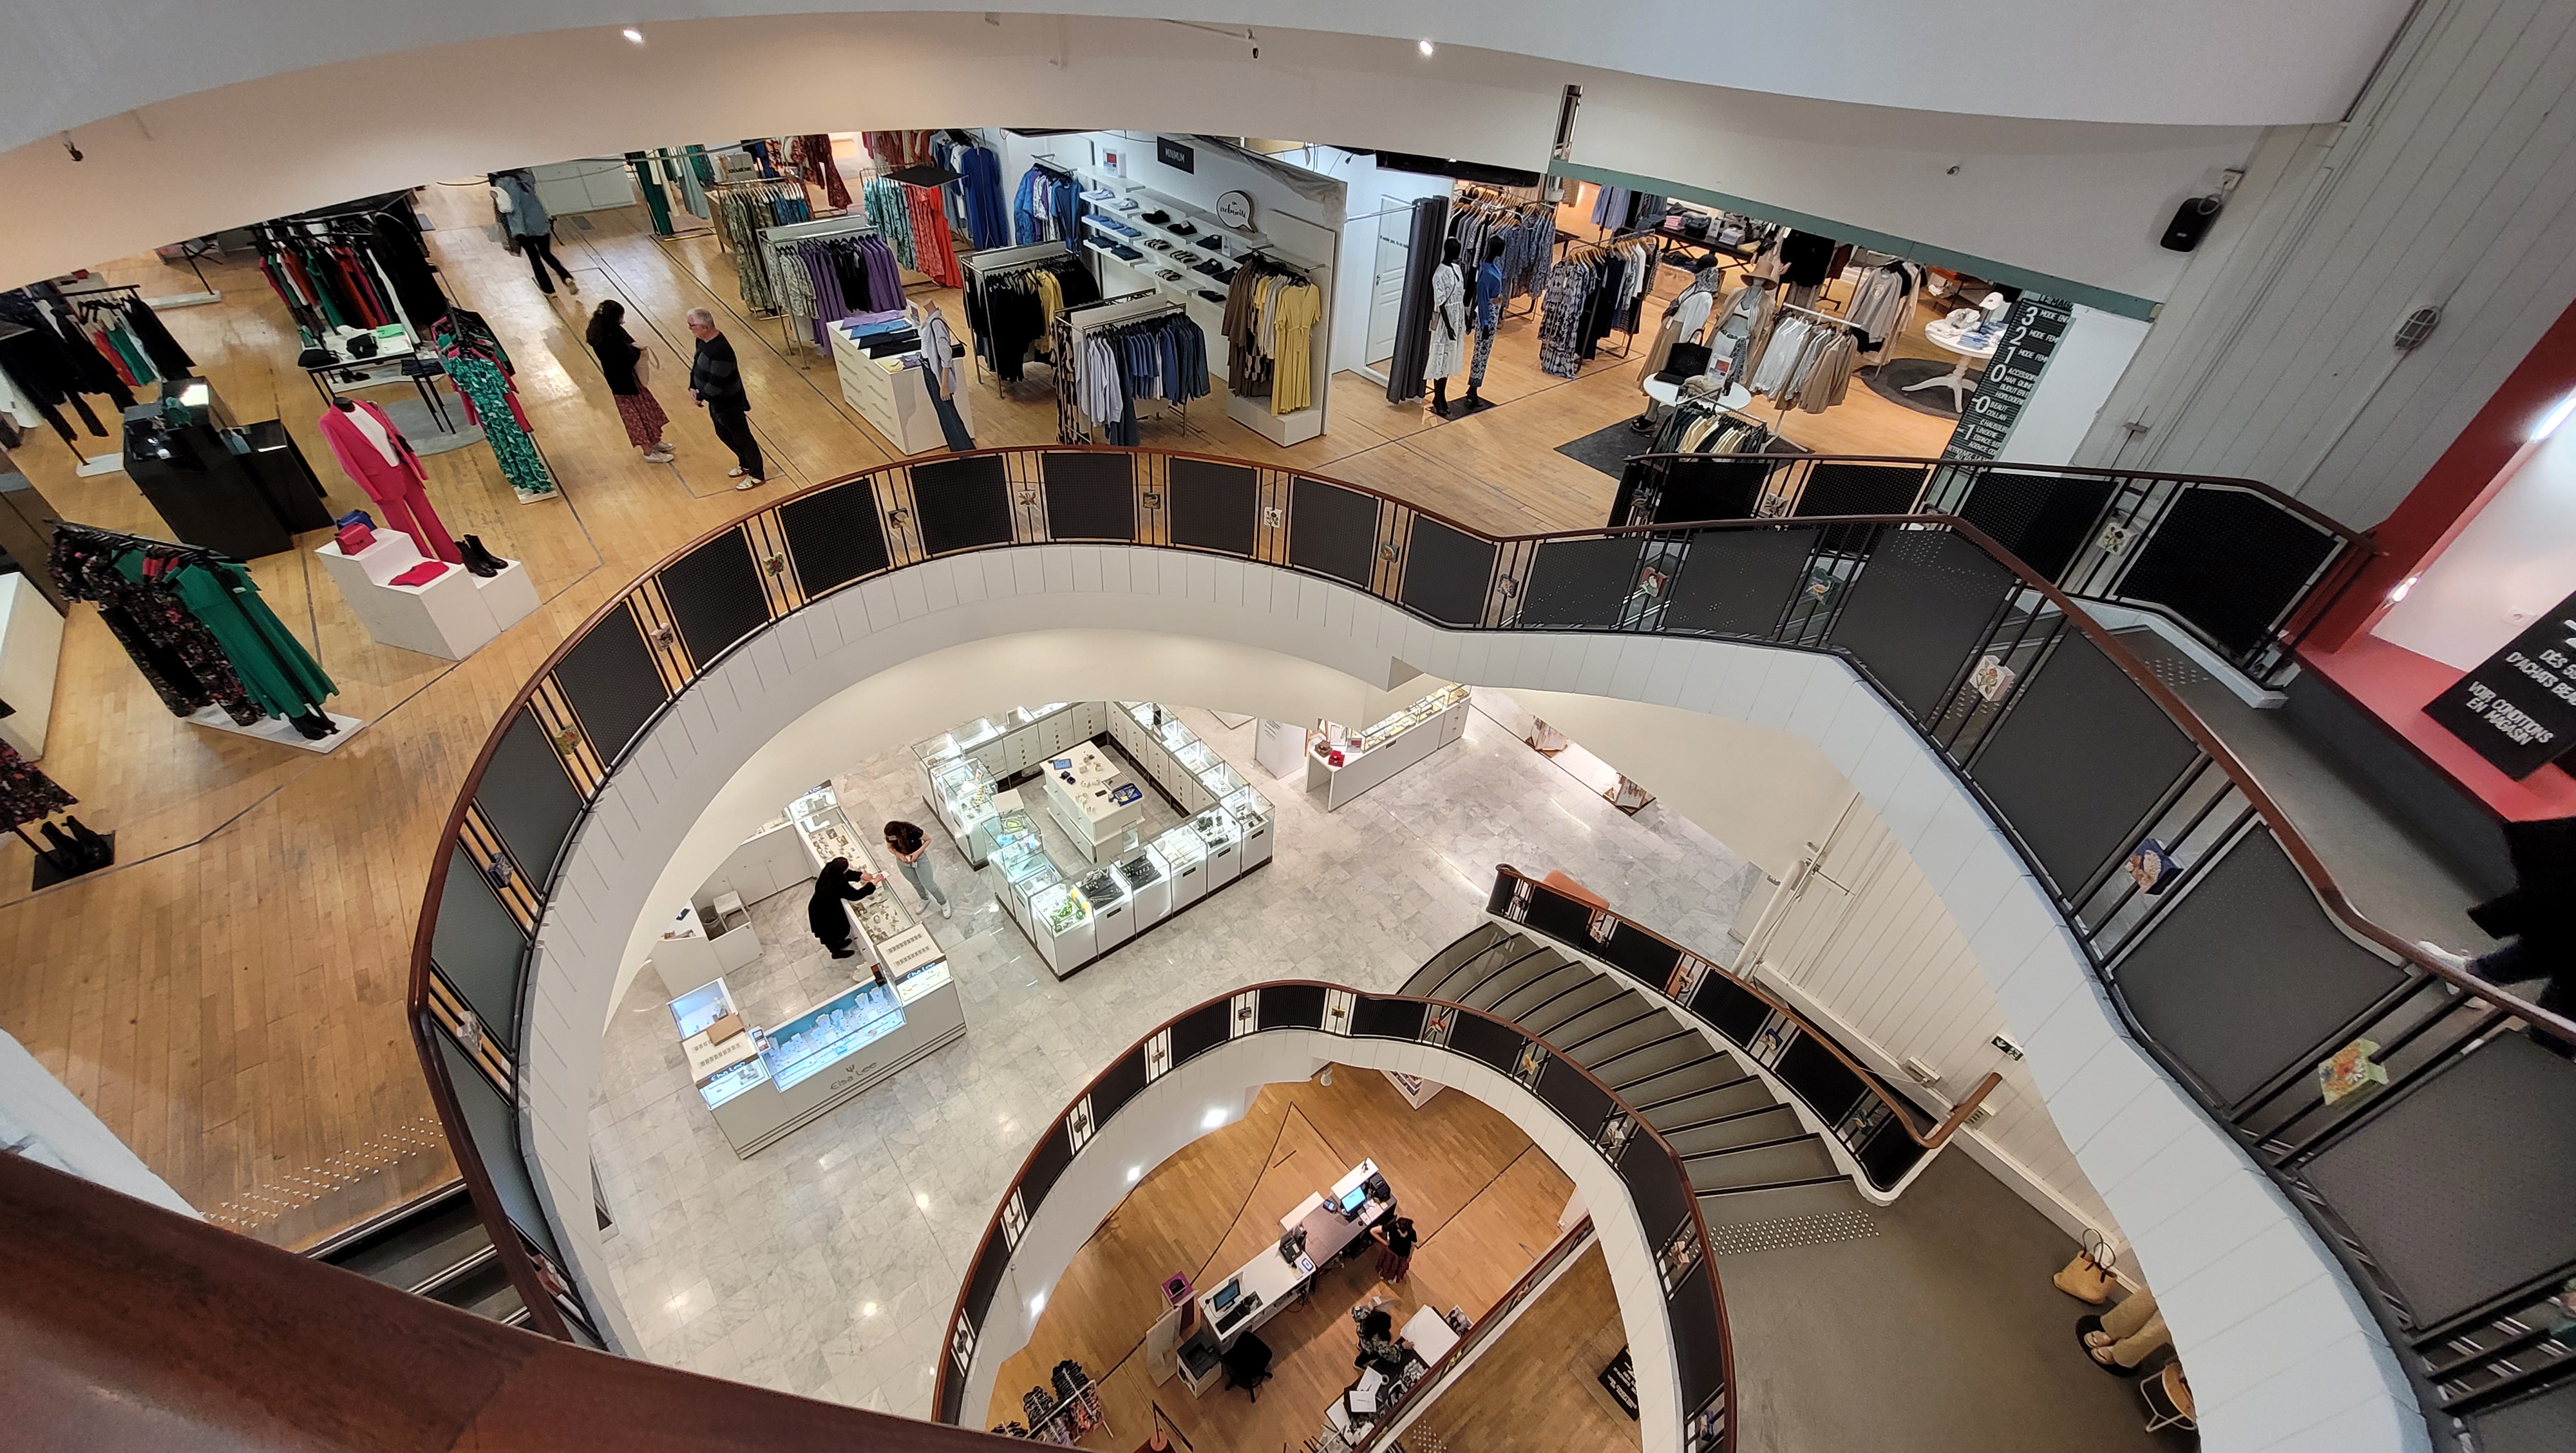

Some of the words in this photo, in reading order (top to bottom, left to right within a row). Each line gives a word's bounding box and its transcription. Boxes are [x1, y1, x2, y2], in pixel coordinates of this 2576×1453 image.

[1165, 147, 1185, 163] MINIMUM
[2021, 306, 2038, 326] 3
[2039, 309, 2057, 319] MODE
[2009, 326, 2027, 346] 2
[2028, 329, 2046, 339] MODE
[2045, 333, 2060, 343] FEM
[2003, 346, 2017, 364] 1
[2018, 348, 2035, 359] MODE
[2034, 354, 2049, 363] FEM
[1990, 364, 2006, 383] 0
[2505, 651, 2559, 688] D'ACHATS
[2465, 696, 2488, 713] EN
[2483, 710, 2535, 746] MAGASIN
[2468, 680, 2496, 704] VOIR
[2491, 698, 2554, 743] CONDITIONS
[710, 1070, 728, 1082] Elsa
[728, 1061, 746, 1074] Lee
[830, 1076, 854, 1090] Elsa
[856, 1062, 877, 1076] Lee
